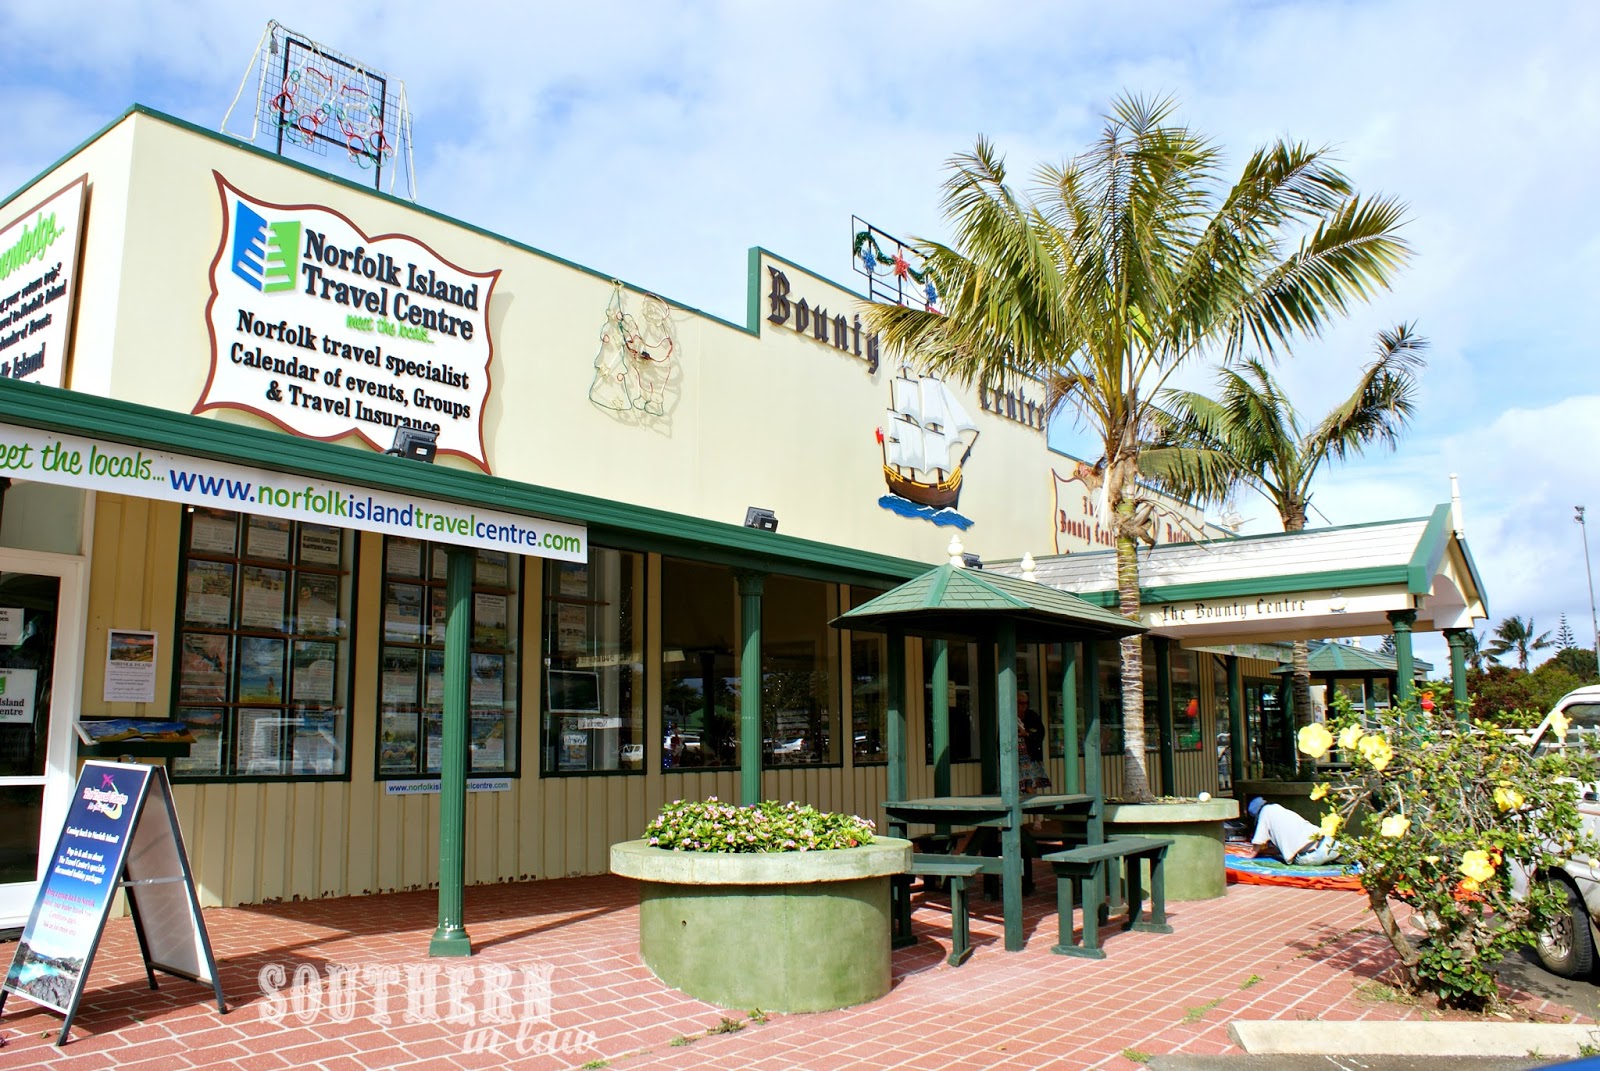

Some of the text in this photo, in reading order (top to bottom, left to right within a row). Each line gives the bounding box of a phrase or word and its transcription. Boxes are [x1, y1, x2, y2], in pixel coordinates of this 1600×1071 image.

[0, 212, 65, 281] nowledge...
[304, 228, 479, 311] Norfolk Island
[302, 262, 474, 340] Travel Centre
[346, 313, 374, 330] meet
[376, 317, 396, 336] the
[767, 264, 879, 375] Bounty
[230, 342, 471, 419] Calendar of events, Groups
[237, 308, 470, 390] Norfolk travel specialist
[265, 379, 441, 433] & Travel Insurance
[0, 443, 33, 470] eet
[41, 441, 83, 476] the
[89, 445, 166, 481] locals...
[169, 469, 581, 553] www.norfolkislandtravelcentre.com
[1060, 509, 1091, 545] Bounty
[1161, 598, 1306, 622] The Bounty Centre
[0, 708, 24, 716] entre
